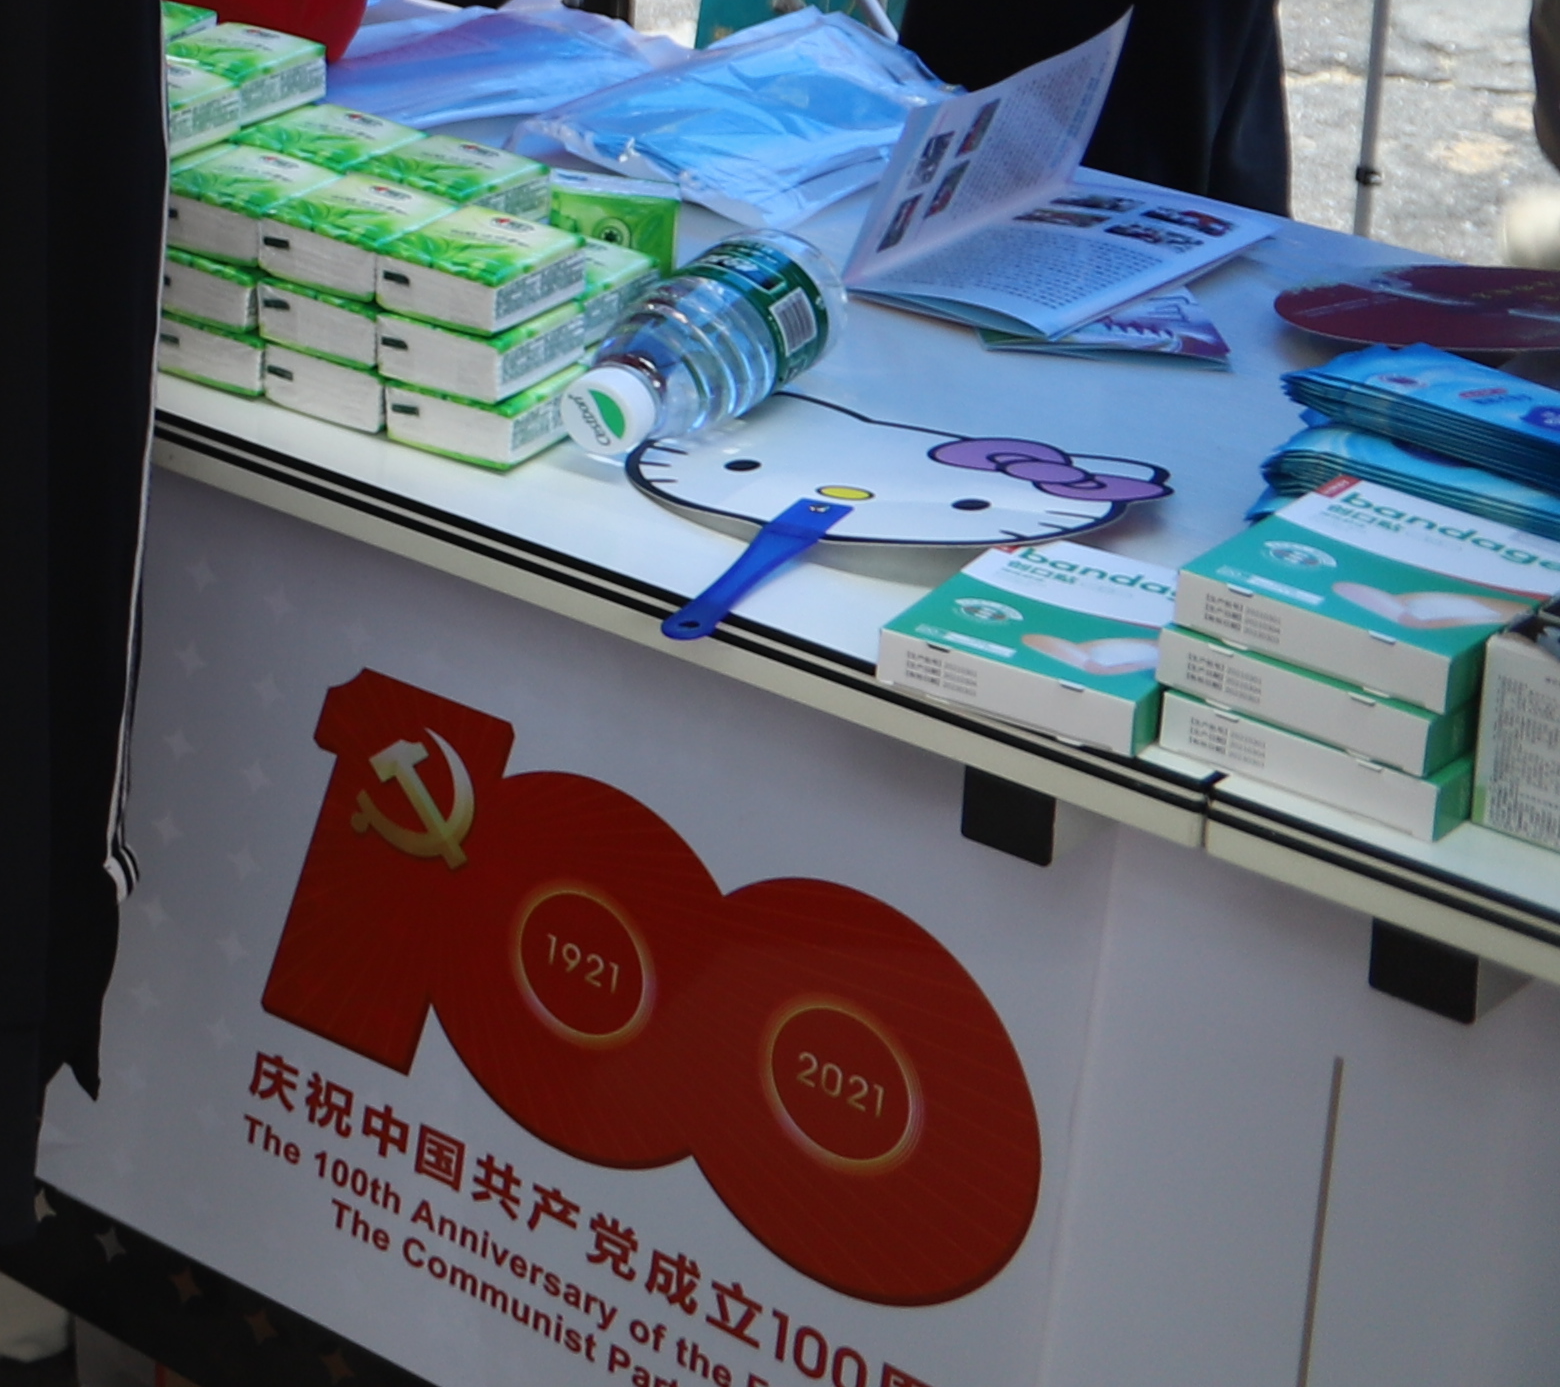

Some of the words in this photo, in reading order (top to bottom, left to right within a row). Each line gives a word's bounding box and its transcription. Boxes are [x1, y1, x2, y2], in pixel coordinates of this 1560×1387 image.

[1019, 547, 1177, 601] banda
[547, 933, 620, 995] 1921
[796, 1051, 885, 1118] 2021
[244, 1113, 301, 1165] The
[314, 1150, 402, 1215] 100th
[410, 1199, 618, 1331] Anniversary
[629, 1319, 667, 1352] of
[676, 1336, 732, 1387] the
[331, 1197, 391, 1252] The
[402, 1236, 597, 1363] Communist
